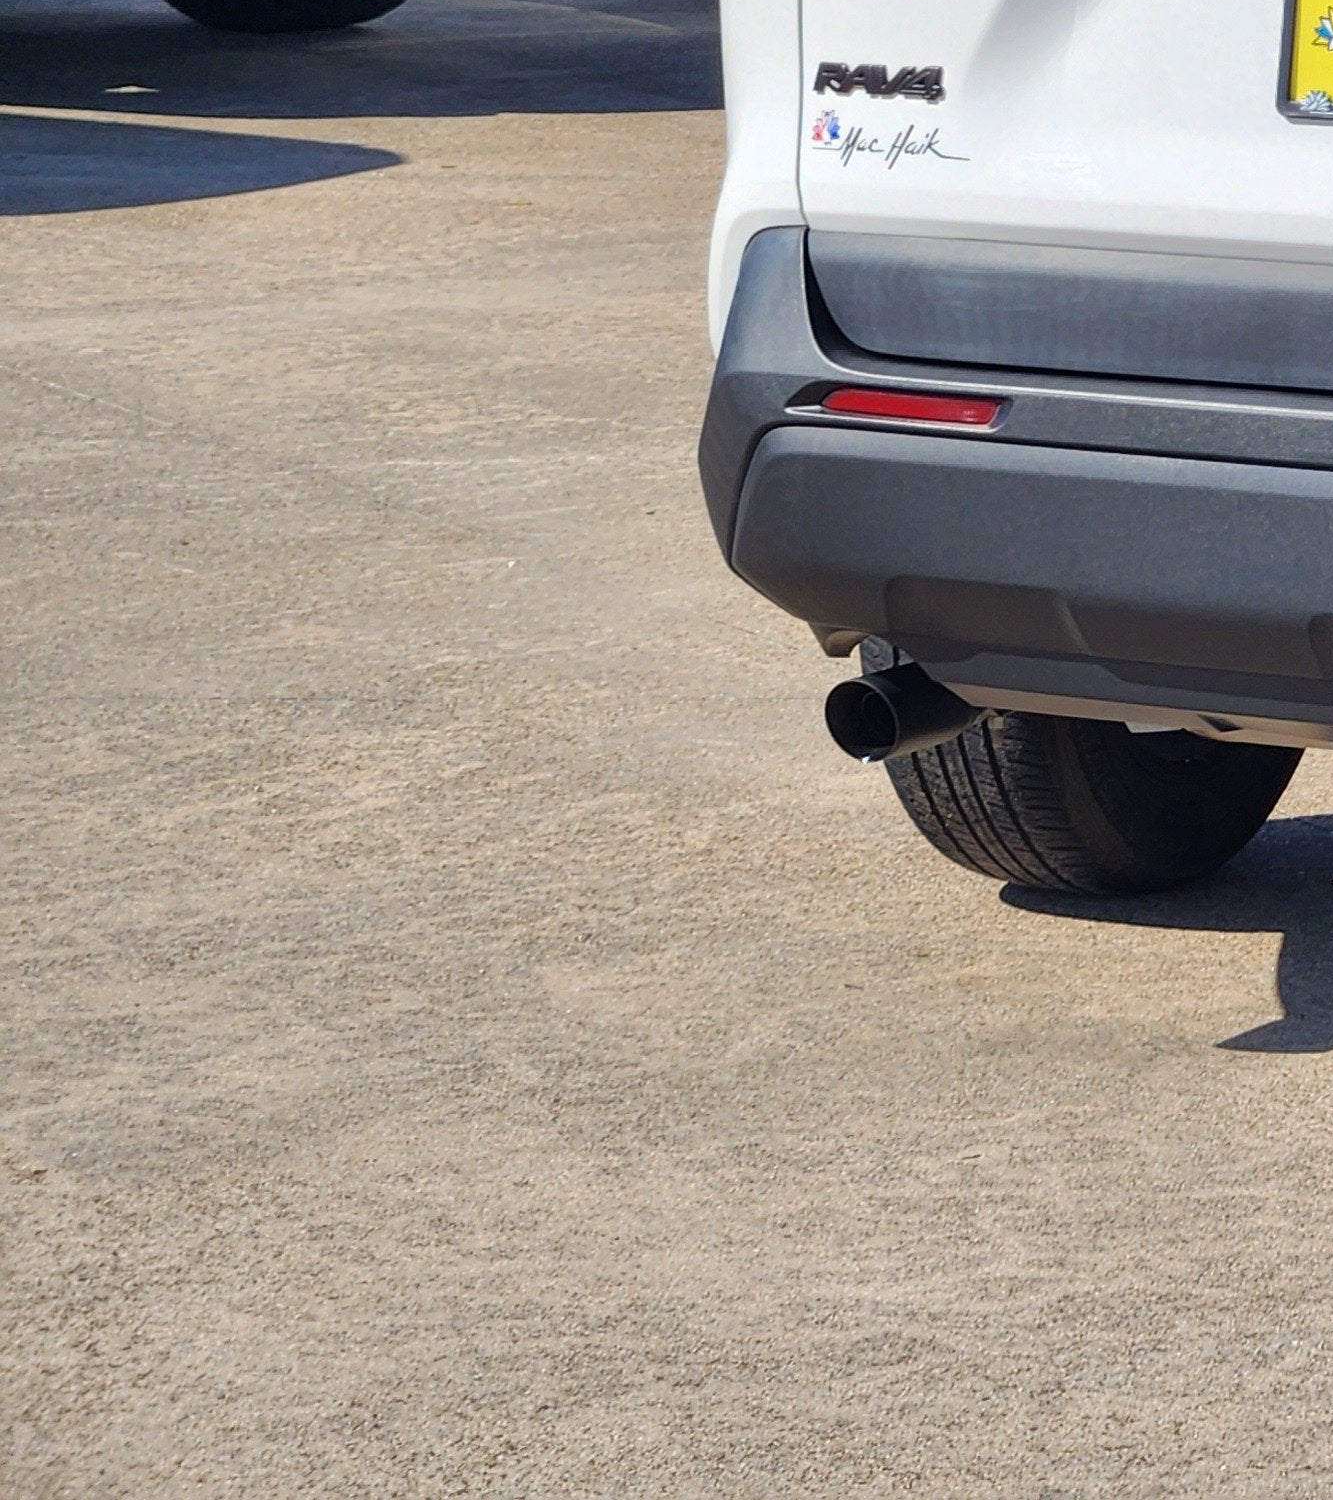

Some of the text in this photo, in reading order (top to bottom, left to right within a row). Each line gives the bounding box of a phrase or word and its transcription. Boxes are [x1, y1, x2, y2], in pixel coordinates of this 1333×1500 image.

[813, 61, 946, 103] RAV4
[840, 124, 965, 170] Mac Haik
